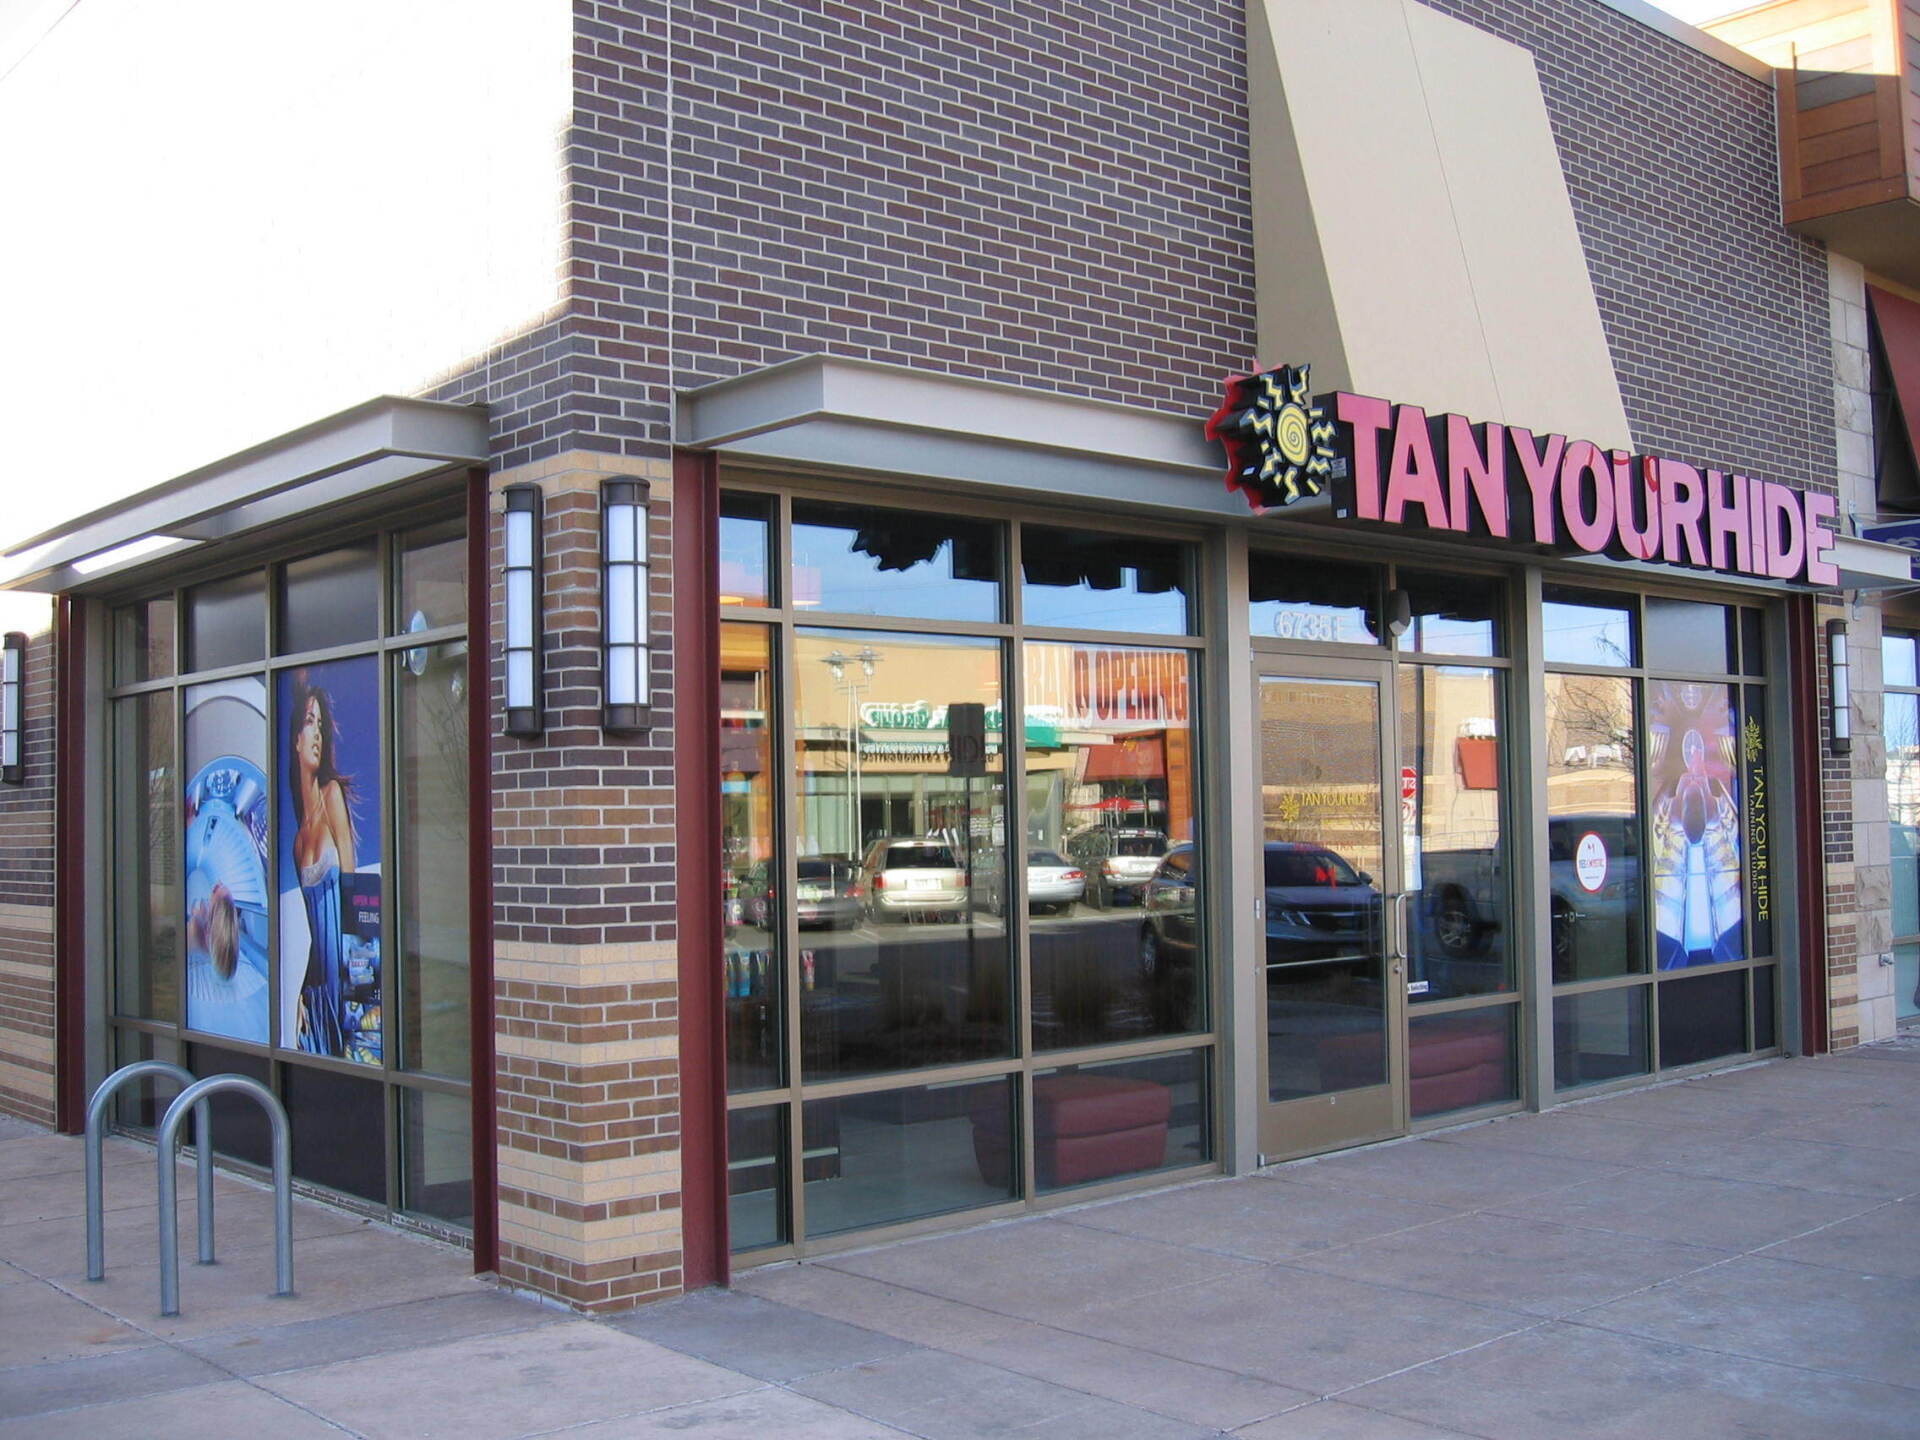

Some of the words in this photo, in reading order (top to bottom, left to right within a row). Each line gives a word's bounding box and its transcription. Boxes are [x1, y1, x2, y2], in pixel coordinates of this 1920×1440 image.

[1026, 647, 1091, 720] RAND
[1095, 650, 1189, 721] OPENING
[1754, 766, 1765, 808] TAN
[1755, 814, 1767, 870] YOUR
[358, 911, 380, 924] FEELING
[1757, 875, 1769, 922] HIDE
